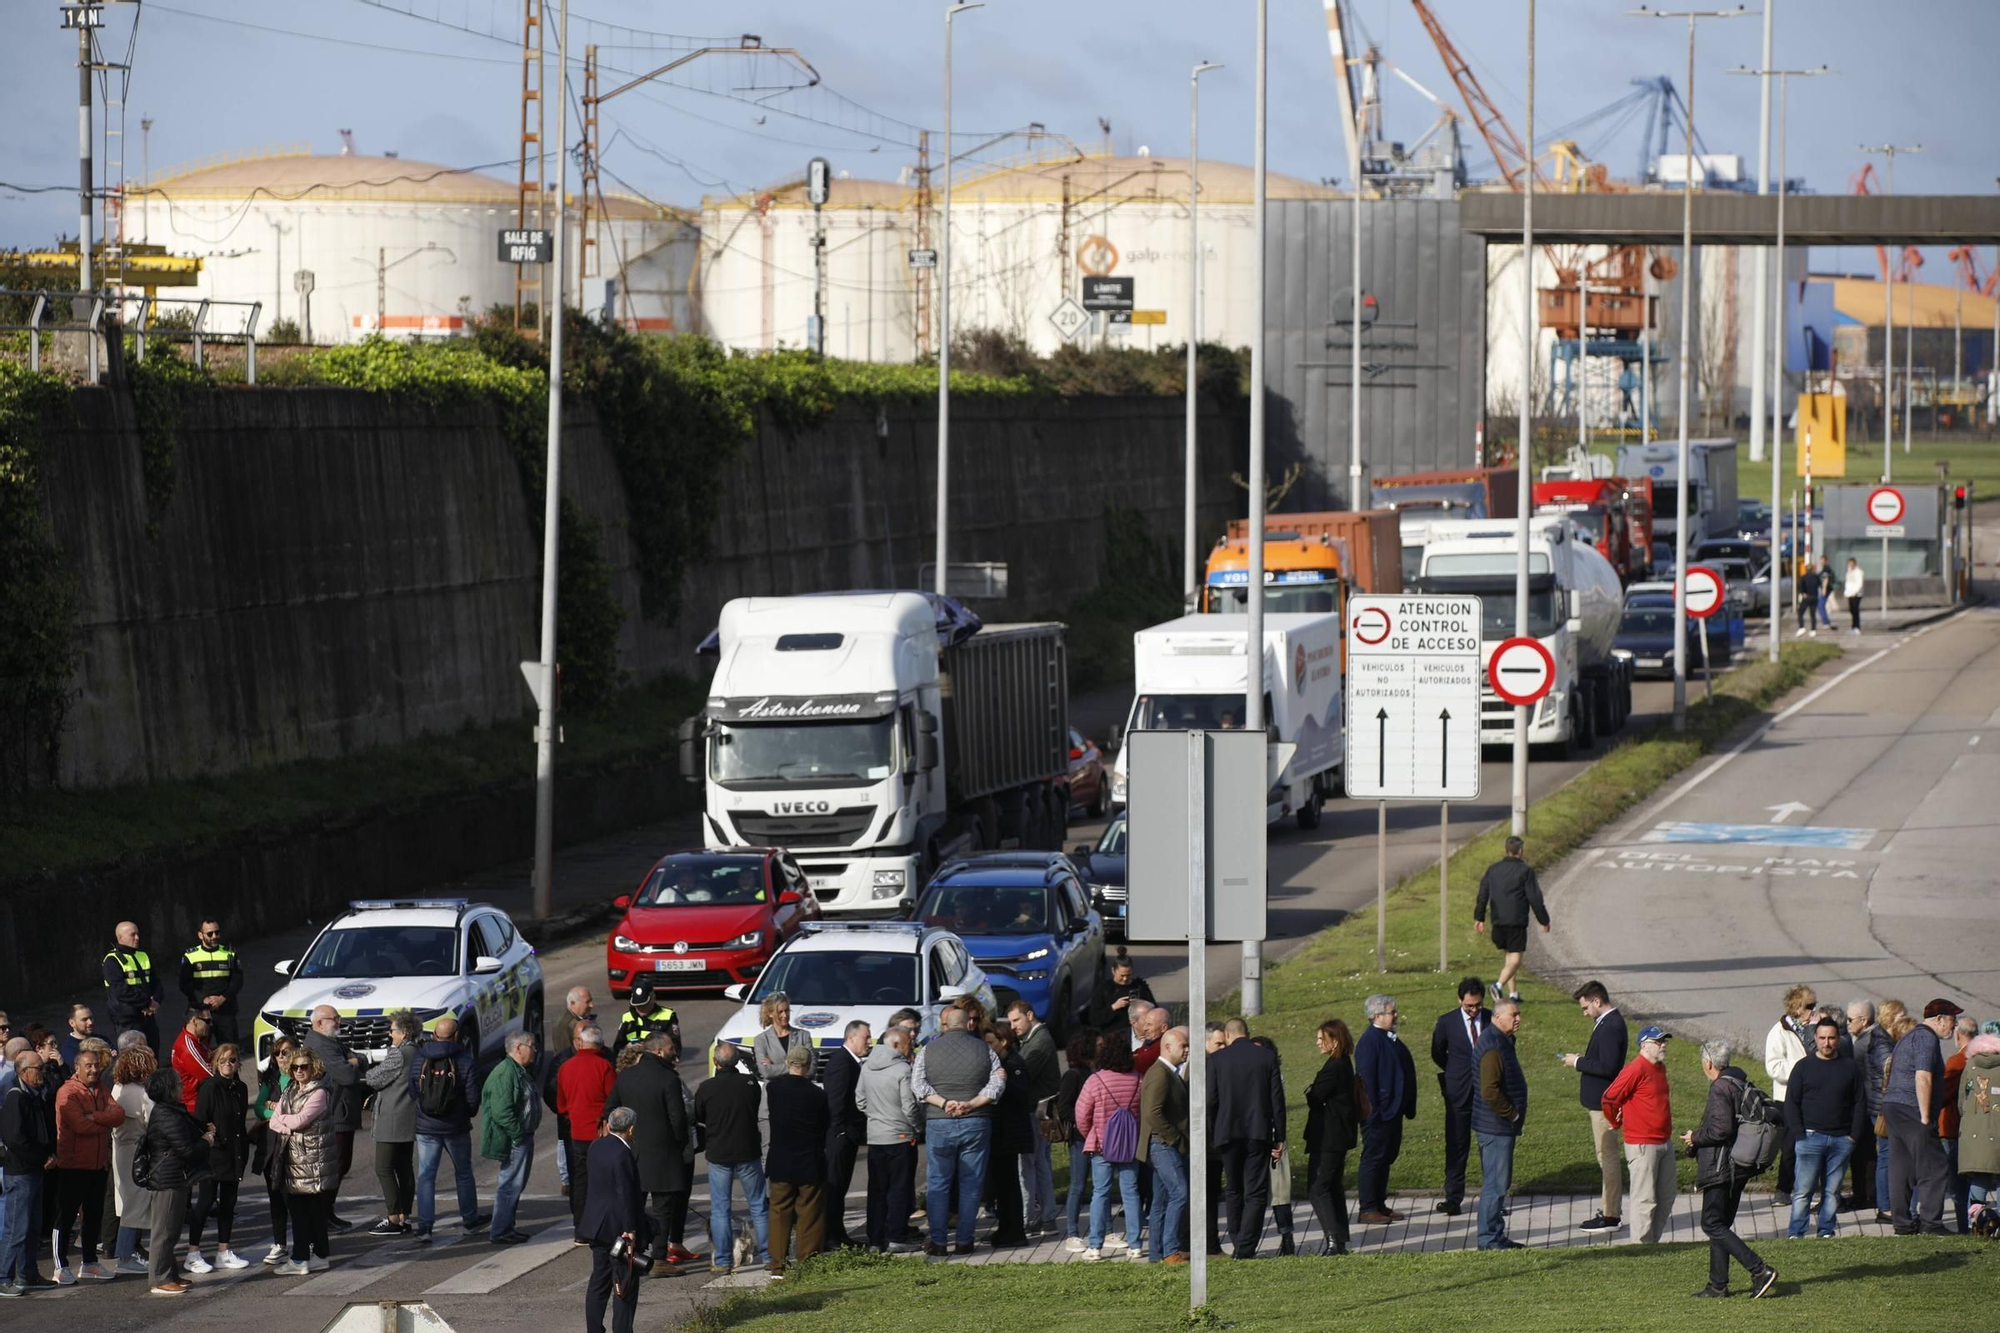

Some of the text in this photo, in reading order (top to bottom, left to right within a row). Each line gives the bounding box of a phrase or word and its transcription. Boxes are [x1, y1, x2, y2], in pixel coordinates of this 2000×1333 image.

[504, 231, 544, 245] SALE DE
[1126, 246, 1160, 264] galp
[1060, 311, 1078, 326] 20
[1398, 603, 1471, 615] ATENCION
[1400, 620, 1468, 632] CONTROL
[1391, 638, 1477, 650] DE ACCESO
[1362, 664, 1405, 672] VEHICULOS
[1423, 664, 1465, 672] VEHICULOS
[1419, 677, 1471, 685] AUTORIZADOS
[1356, 688, 1410, 697] AUTORIZADOS
[773, 801, 829, 814] IVECO
[1618, 851, 1707, 862] DEL
[1594, 860, 1859, 879] AUTOPISTA
[661, 960, 684, 970] 5653
